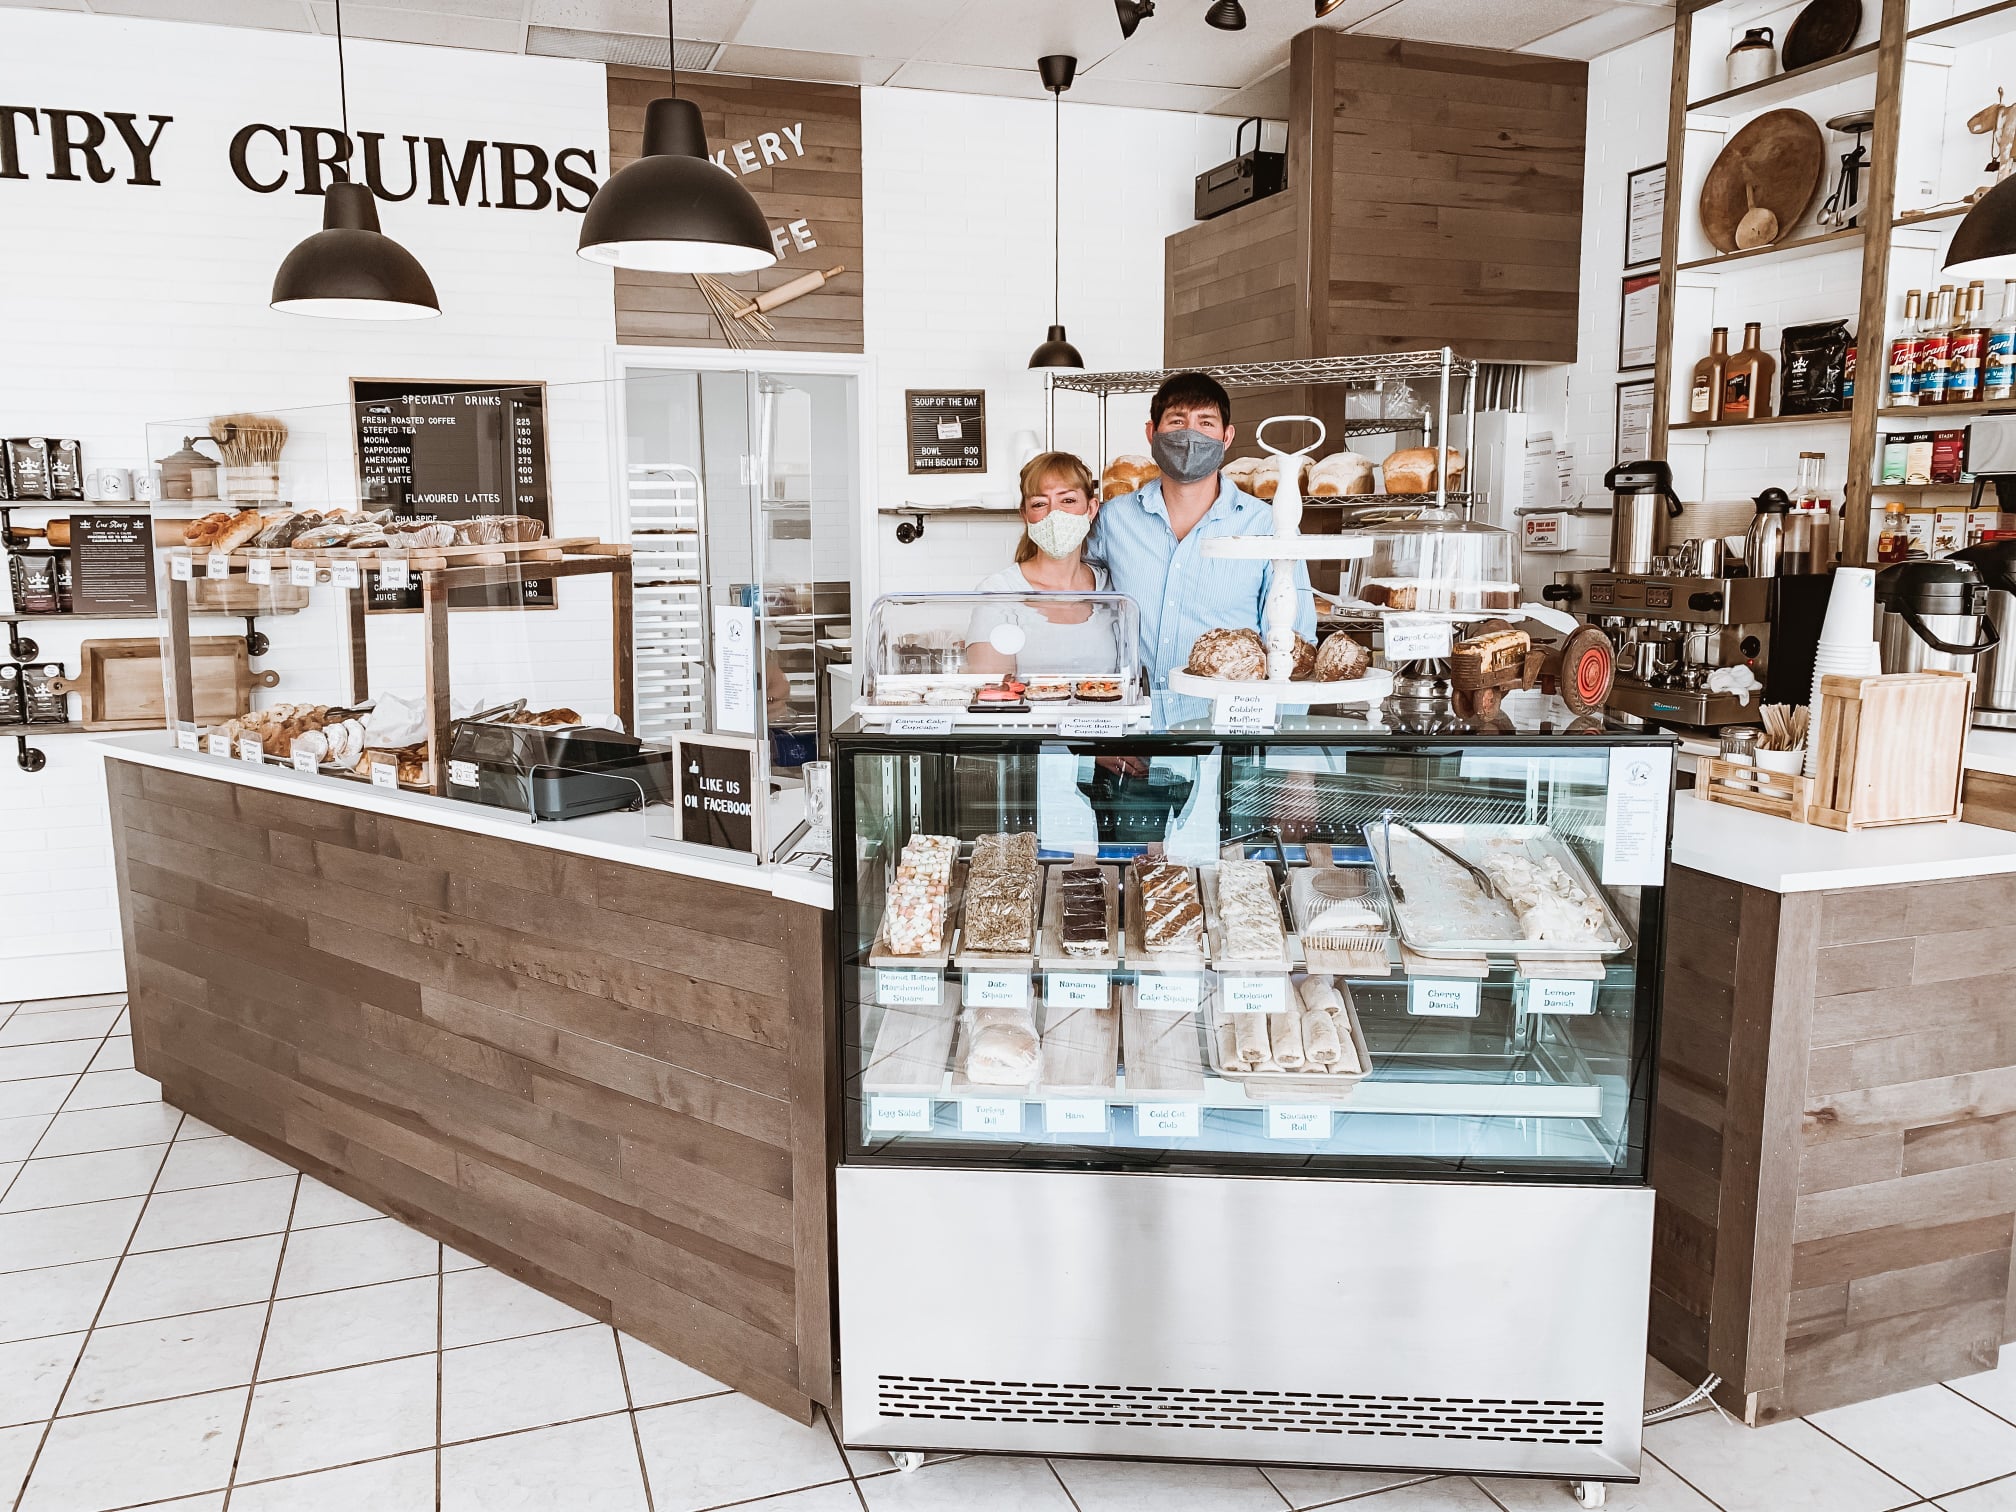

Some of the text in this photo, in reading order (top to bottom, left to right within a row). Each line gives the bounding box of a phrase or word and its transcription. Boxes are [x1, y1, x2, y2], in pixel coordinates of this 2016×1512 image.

[229, 123, 601, 213] CRUMBS
[401, 395, 501, 406] SPECIALTY DRINKS
[914, 398, 978, 406] SOUP OF THE DAY
[361, 416, 531, 426] FRESH ROASTED COFFEE 225
[363, 426, 531, 436] STEEPED TEA 180
[516, 437, 531, 445] 420
[364, 446, 411, 454] CAPPUCCINO
[921, 446, 979, 455] BOWL 600
[365, 456, 408, 464] AMERICANO
[915, 458, 979, 467] WITH BISCUIT 750
[366, 466, 532, 474] FLAT WHITE 400
[366, 476, 385, 484] CAFE
[388, 476, 412, 484] LATTE
[406, 494, 459, 503] FLAVOURED
[465, 494, 501, 503] LATTES
[95, 520, 128, 530] Our Story
[525, 580, 538, 588] 150
[375, 593, 397, 601] JUICE
[1234, 695, 1260, 703] Peach
[699, 777, 740, 795] LIKE US
[684, 794, 751, 815] ON FACEBOOK
[987, 980, 1008, 988] Date
[1059, 981, 1096, 989] Nanaimo
[1069, 992, 1085, 1000] Bar
[1233, 992, 1273, 1000] Explosion
[1428, 989, 1461, 1000] Cherry
[1544, 988, 1575, 996] Lemon
[1429, 1001, 1459, 1009] Danish
[1544, 999, 1574, 1007] Danish
[878, 1109, 921, 1118] Egg Salad
[1150, 1110, 1169, 1118] Cold
[1280, 1112, 1318, 1121] Sausage
[1291, 1123, 1307, 1131] Roll
